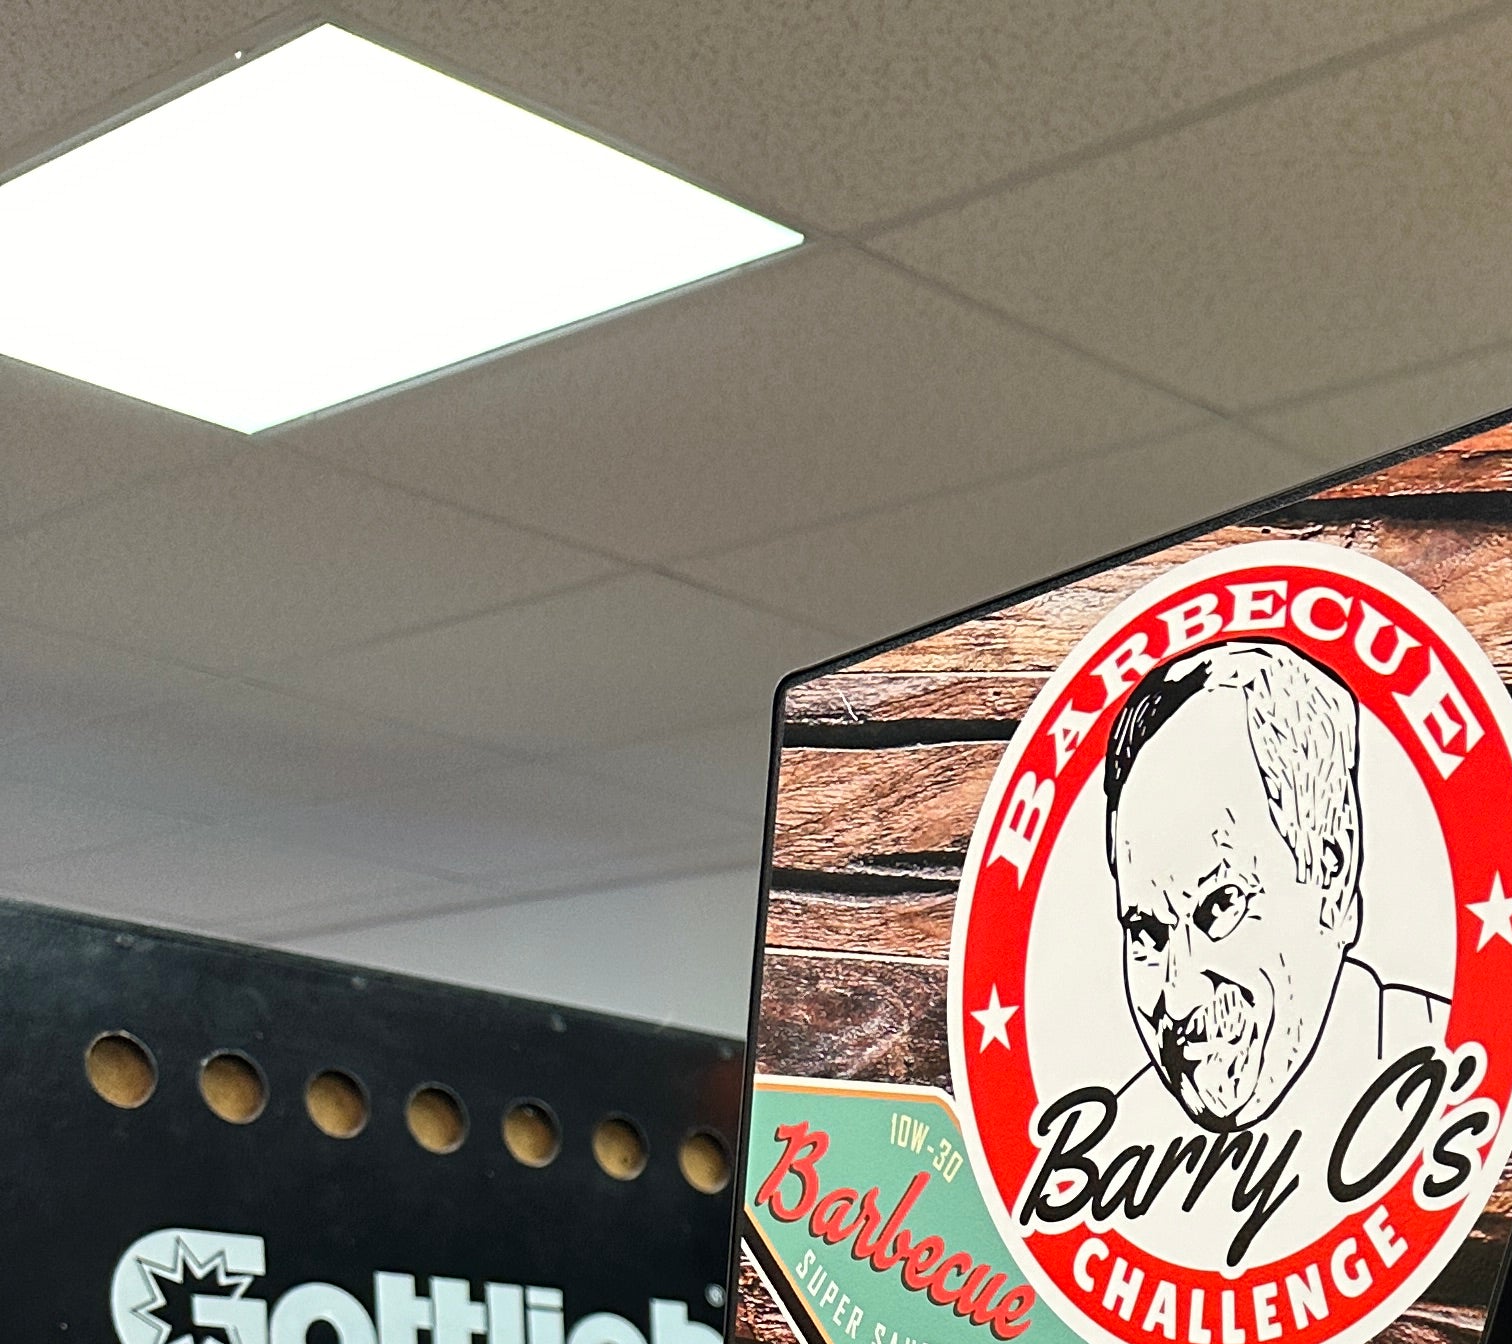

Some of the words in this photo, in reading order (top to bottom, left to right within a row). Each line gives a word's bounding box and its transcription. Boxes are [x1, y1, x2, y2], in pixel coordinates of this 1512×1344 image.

[987, 580, 1486, 890] BARBECUE
[754, 1120, 1038, 1342] Barbecue
[890, 1112, 964, 1184] 10W-30
[1020, 1085, 1302, 1267] Barry
[1325, 1046, 1492, 1196] O's
[795, 1249, 864, 1340] SUPER
